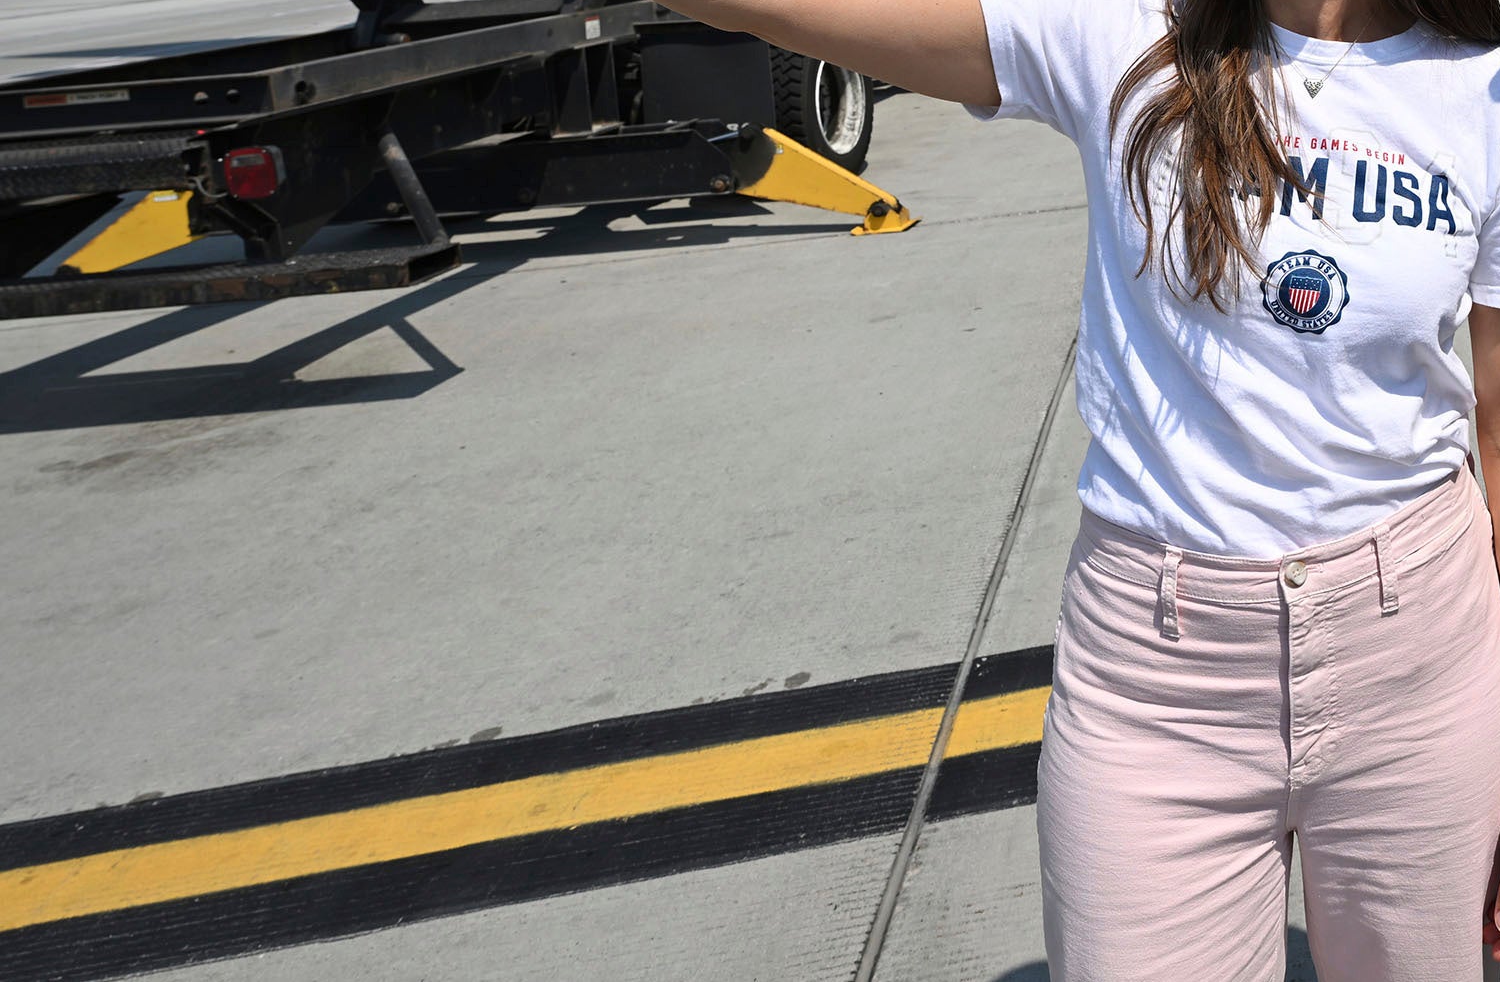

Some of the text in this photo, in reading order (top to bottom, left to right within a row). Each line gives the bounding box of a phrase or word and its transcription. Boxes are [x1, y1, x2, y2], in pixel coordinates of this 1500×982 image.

[1310, 137, 1359, 152] GAMES
[1366, 147, 1405, 166] BEGIN
[1352, 159, 1457, 236] USA
[1278, 257, 1337, 280] TEAM USA
[1270, 300, 1334, 329] UNITED STATES
